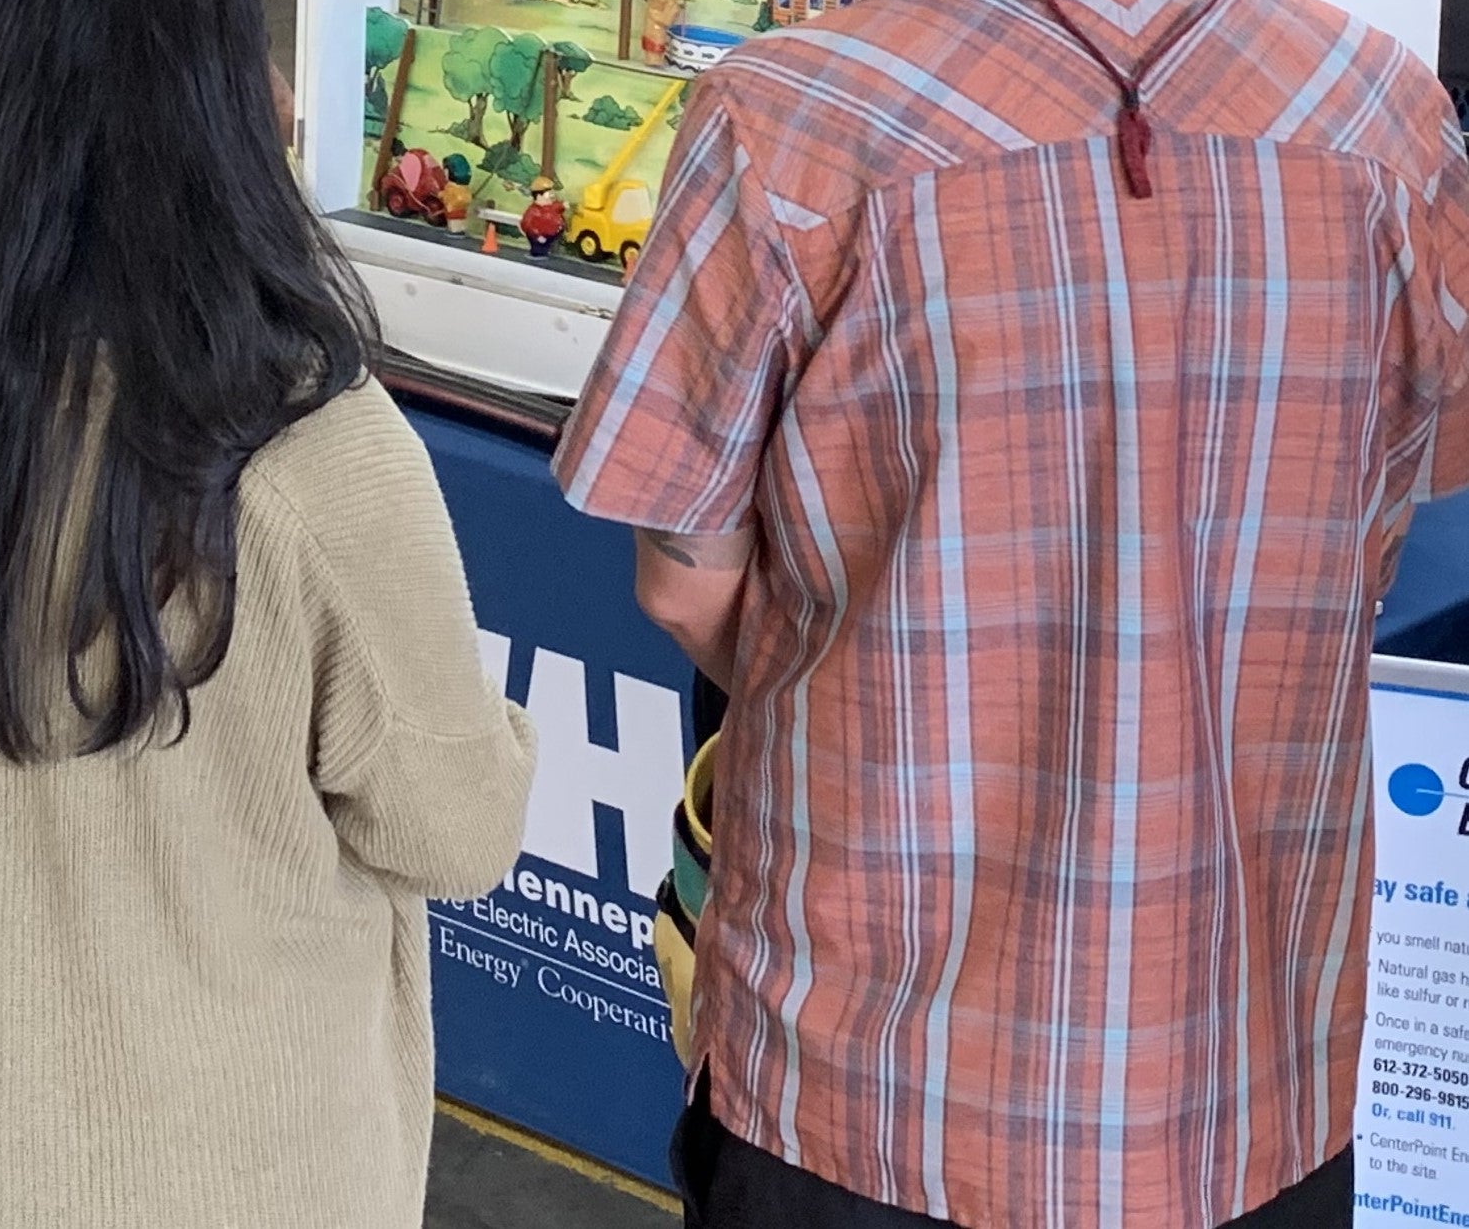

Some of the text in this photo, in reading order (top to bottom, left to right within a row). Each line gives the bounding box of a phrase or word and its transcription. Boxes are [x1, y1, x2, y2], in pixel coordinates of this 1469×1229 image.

[1404, 880, 1459, 907] safe
[473, 896, 661, 989] Electric Associa
[1377, 931, 1401, 946] you
[1405, 935, 1440, 950] smell
[439, 925, 673, 1043] Energy Cooperati
[1378, 958, 1428, 979] Natural
[1432, 970, 1457, 985] gas
[1377, 981, 1400, 998] like
[1403, 987, 1442, 1005] sulfur
[1445, 995, 1460, 1008] or
[1376, 1011, 1410, 1031] Once
[1413, 1016, 1426, 1033] in
[1430, 1022, 1439, 1035] a
[1374, 1037, 1448, 1062] emergency
[1373, 1057, 1469, 1087] 612-372-5050
[1372, 1102, 1392, 1121] Or,
[1397, 1108, 1425, 1125] call
[1370, 1132, 1448, 1160] CenterPoint
[1369, 1157, 1382, 1170] to
[1387, 1158, 1408, 1175] the
